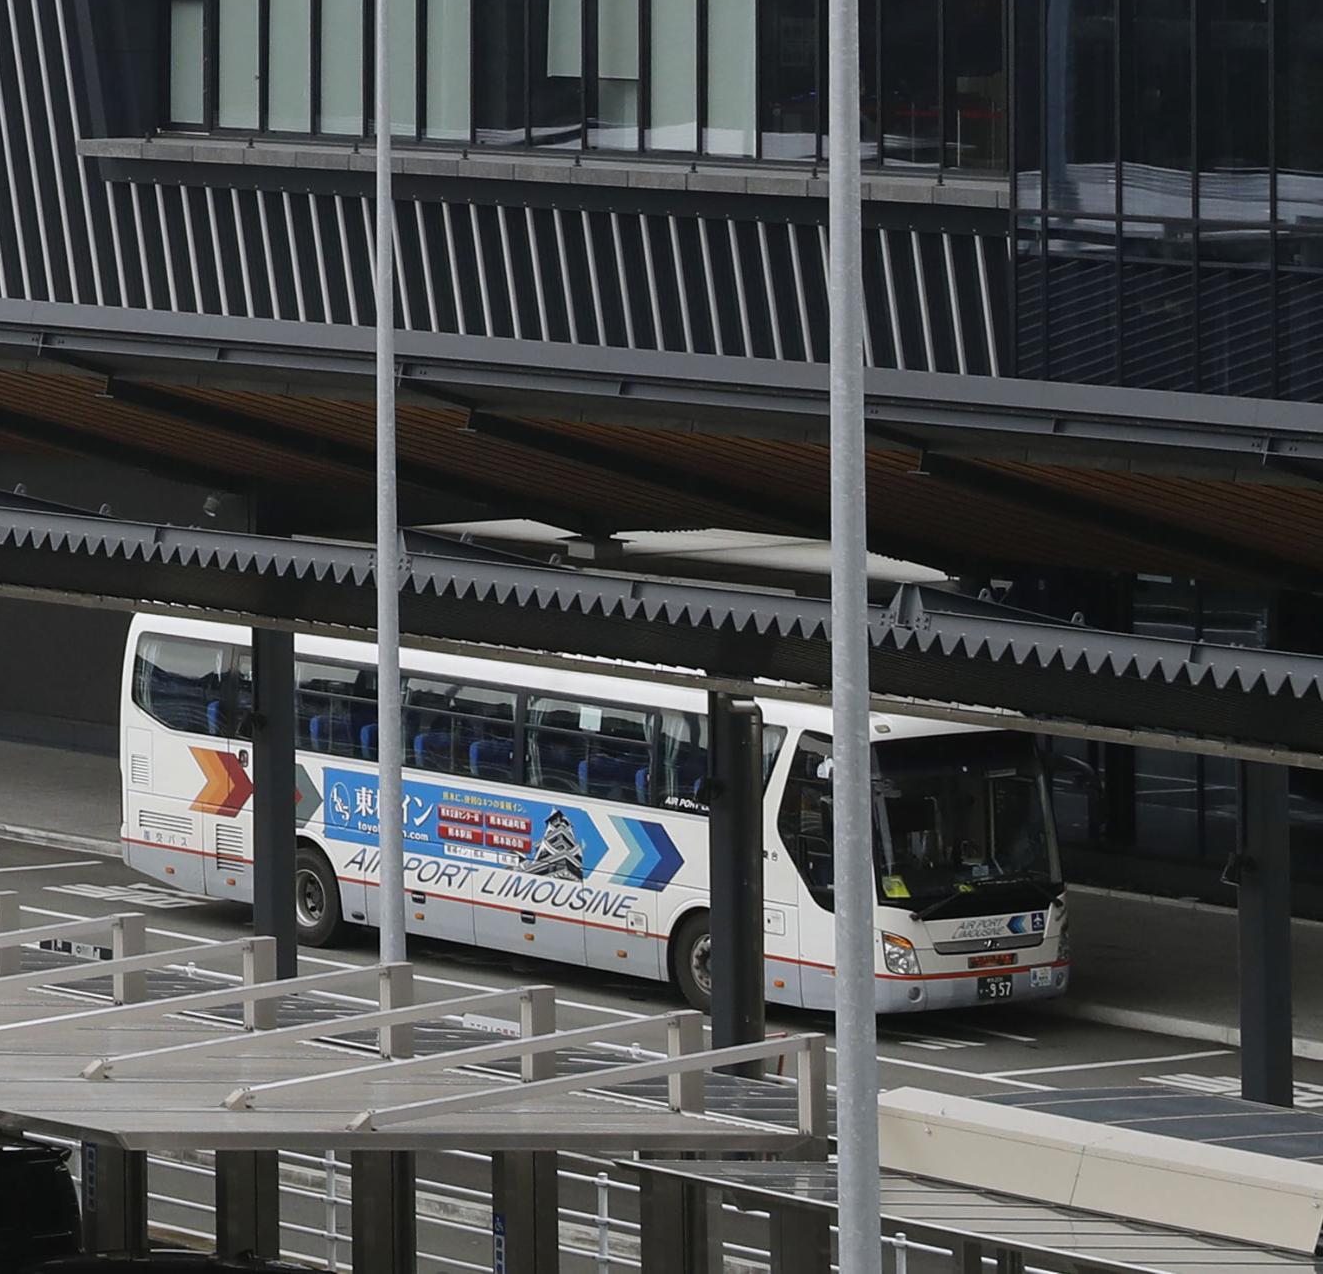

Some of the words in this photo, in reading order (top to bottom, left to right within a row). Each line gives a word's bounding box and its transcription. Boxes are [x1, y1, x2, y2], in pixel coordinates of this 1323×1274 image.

[354, 786, 434, 827] 東イン
[357, 820, 429, 842] toyon.com
[481, 871, 638, 919] LIMOUSINE
